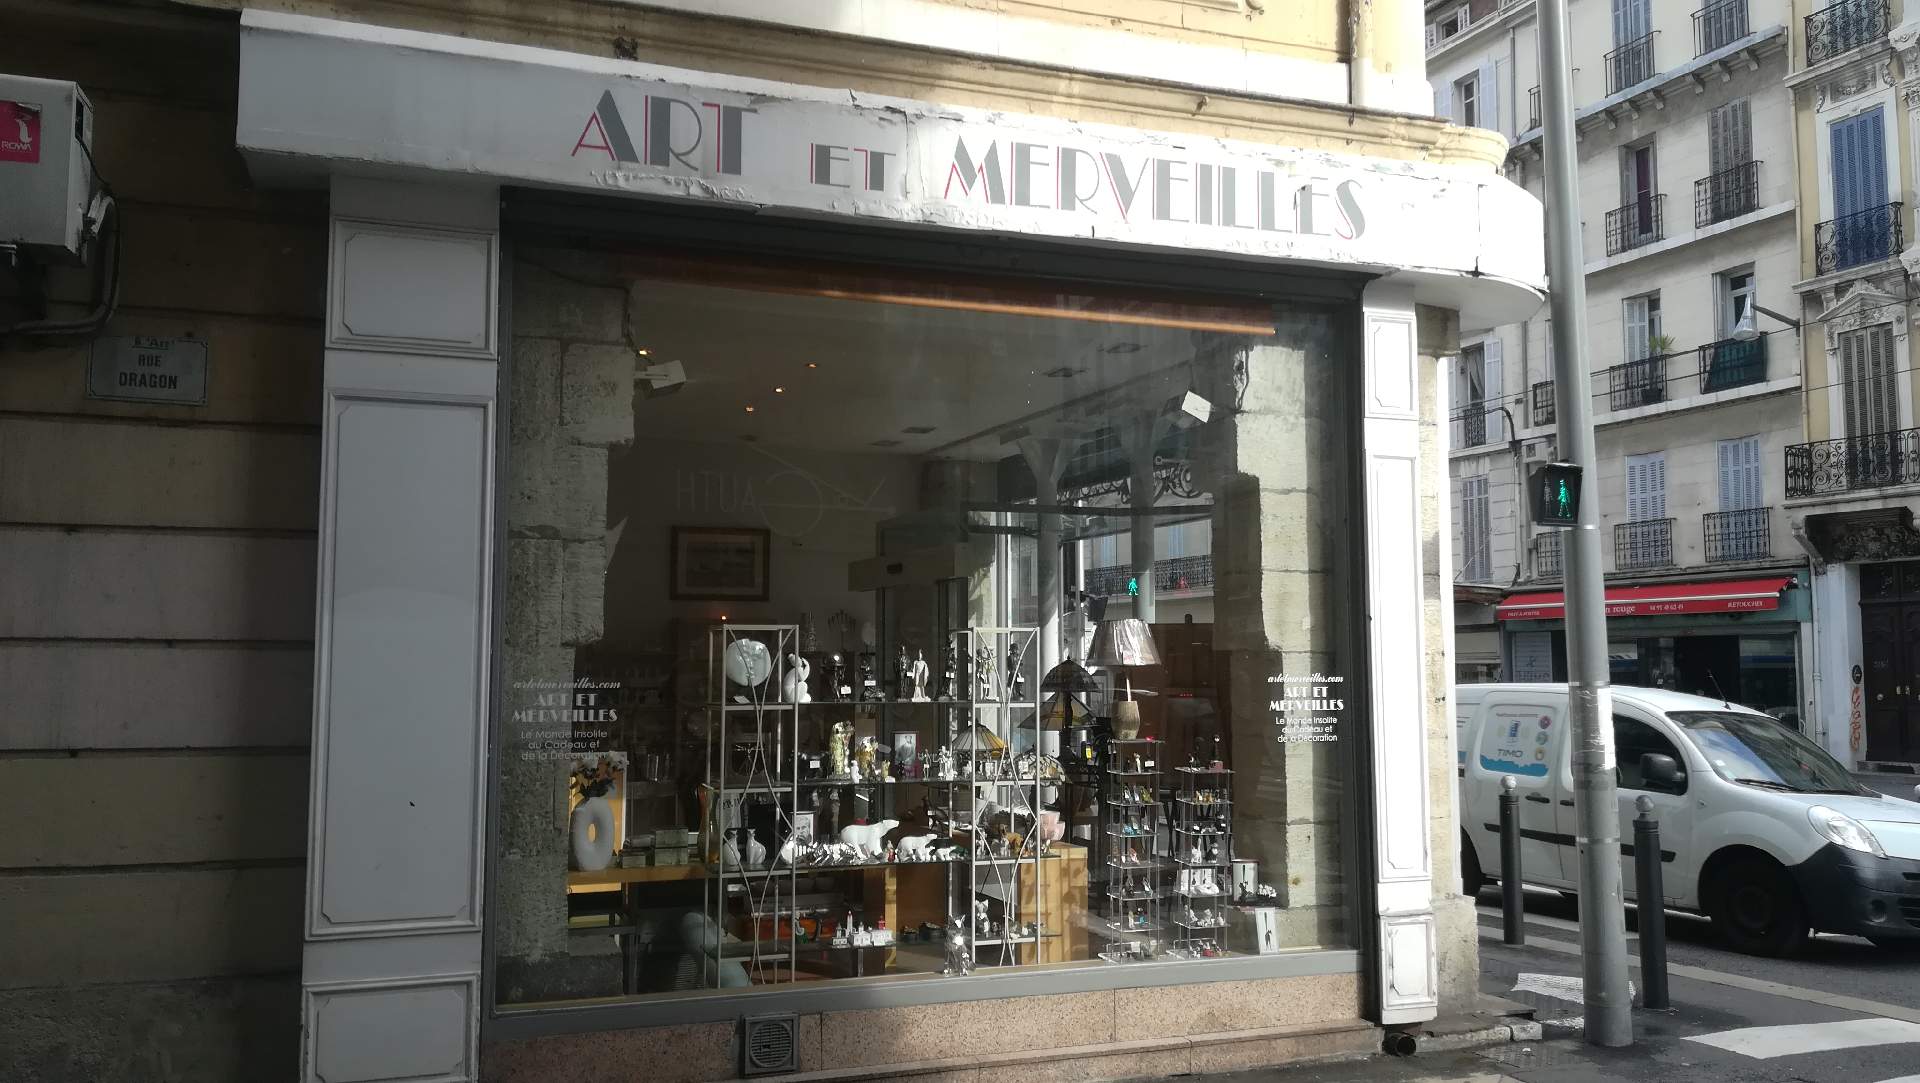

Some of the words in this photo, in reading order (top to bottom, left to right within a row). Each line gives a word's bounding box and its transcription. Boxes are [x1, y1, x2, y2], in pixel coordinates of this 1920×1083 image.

[570, 89, 758, 176] ART
[810, 142, 897, 192] ET
[943, 134, 1367, 240] MERVEILLES
[138, 354, 162, 367] RUE
[119, 371, 178, 389] DRAGON
[1284, 686, 1308, 698] ART
[1312, 686, 1329, 698] ET
[533, 693, 569, 706] ART
[576, 693, 599, 706] ET
[1268, 699, 1345, 711] MERVEILLES
[511, 708, 618, 722] MERVEILLES
[1275, 717, 1285, 725] Le
[1313, 716, 1338, 724] Insolite
[521, 730, 532, 739] Le
[536, 730, 572, 739] Monde
[574, 729, 608, 738] Insolite
[1293, 725, 1323, 733] Cadeau
[1324, 725, 1333, 733] et
[528, 740, 542, 749] du
[544, 740, 587, 749] Cadeau
[589, 740, 600, 749] et
[1277, 734, 1288, 743] de
[521, 750, 536, 760] de
[538, 750, 548, 760] la
